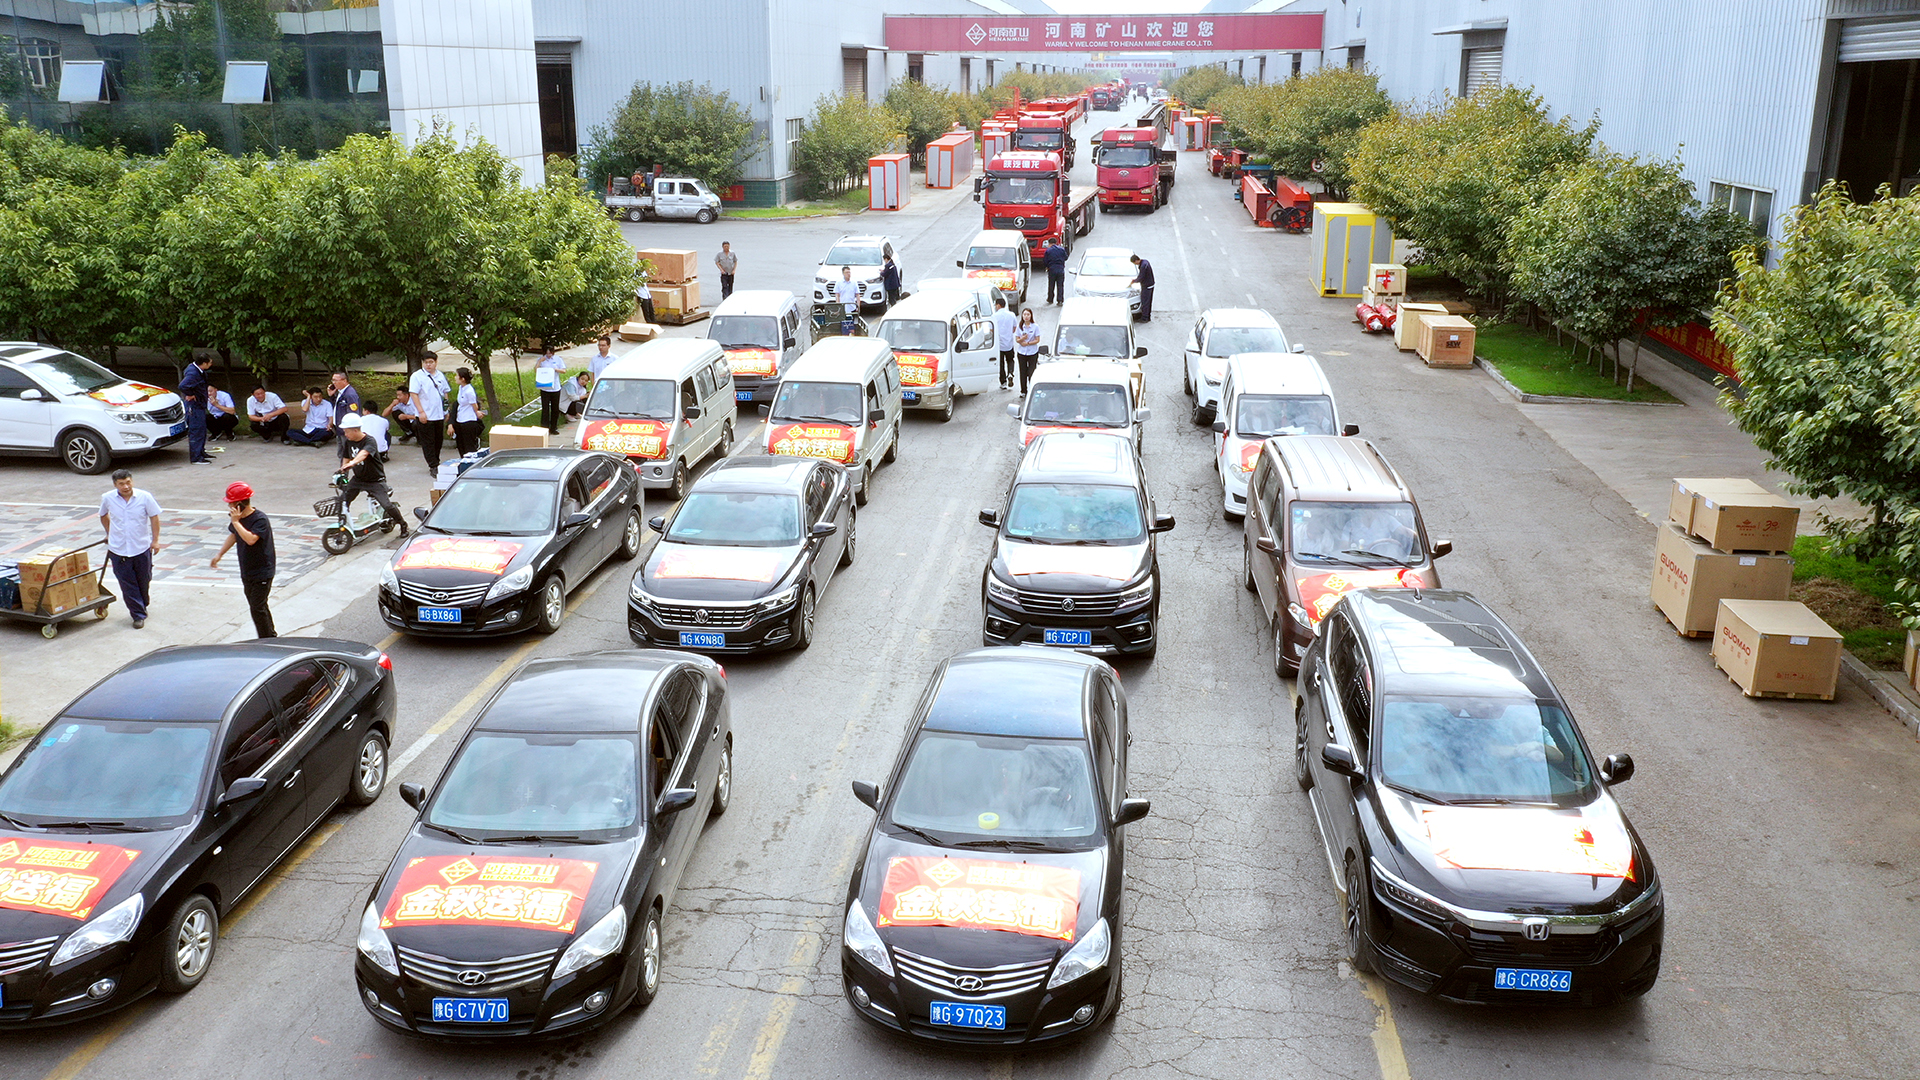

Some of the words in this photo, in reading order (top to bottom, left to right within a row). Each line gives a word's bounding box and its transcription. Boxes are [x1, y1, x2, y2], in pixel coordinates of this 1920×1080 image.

[989, 27, 1029, 37] 河南矿山
[1045, 21, 1214, 38] 河南矿山欢迎您
[588, 434, 662, 456] 金秋送福
[774, 439, 849, 460] 金秋送福
[1660, 553, 1688, 585] GUOMAO
[1723, 626, 1751, 656] GUOMAO
[15, 857, 90, 870] HENANMINE
[22, 846, 100, 864] 河南矿山
[482, 862, 560, 876] 河南矿山
[478, 874, 555, 884] HENANMINE
[396, 886, 572, 925] 金秋送福
[894, 887, 1063, 931] 金秋送福
